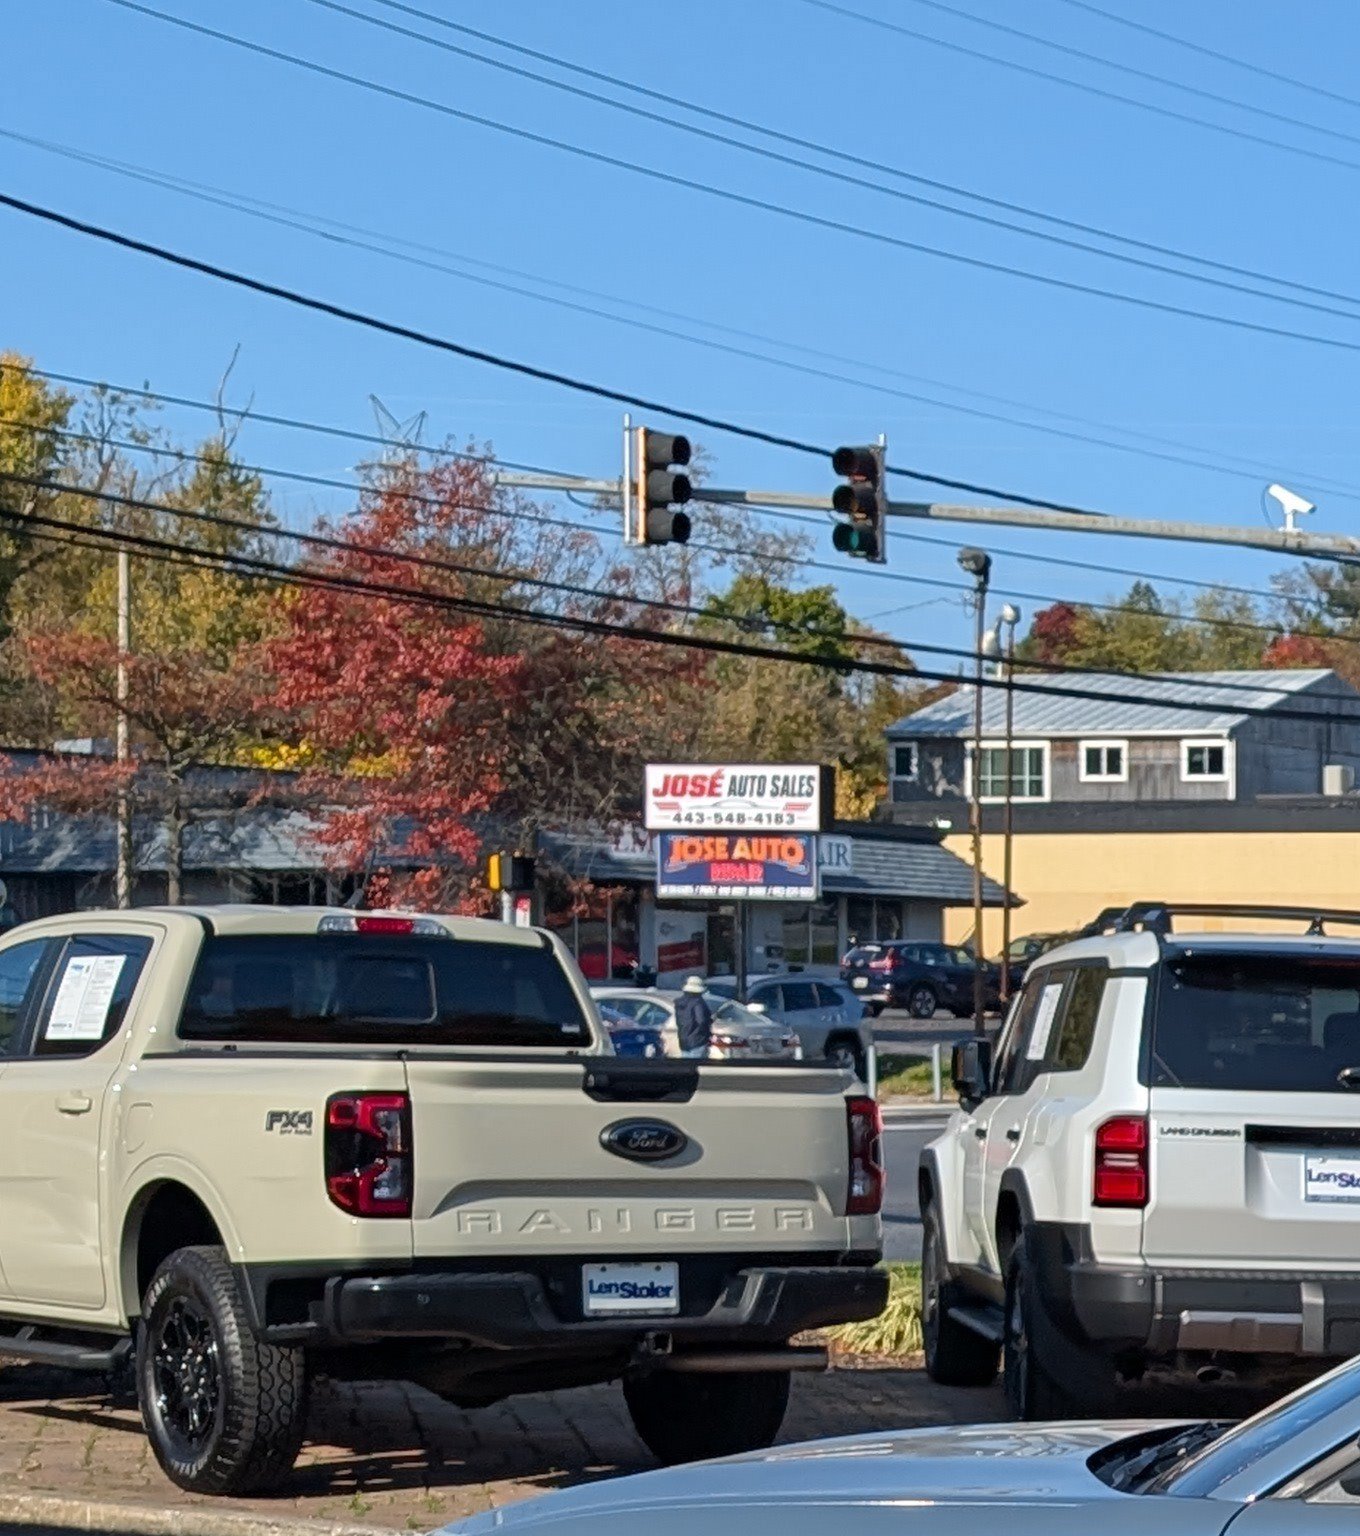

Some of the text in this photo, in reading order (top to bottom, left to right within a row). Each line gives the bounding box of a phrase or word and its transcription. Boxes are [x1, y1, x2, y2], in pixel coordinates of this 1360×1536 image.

[653, 768, 816, 798] JOSÉ AUTO SALES
[669, 836, 729, 863] JOSE
[732, 836, 805, 866] AUTO
[265, 1110, 313, 1131] FX4
[624, 1129, 667, 1150] Ford
[456, 1207, 814, 1235] RANGER
